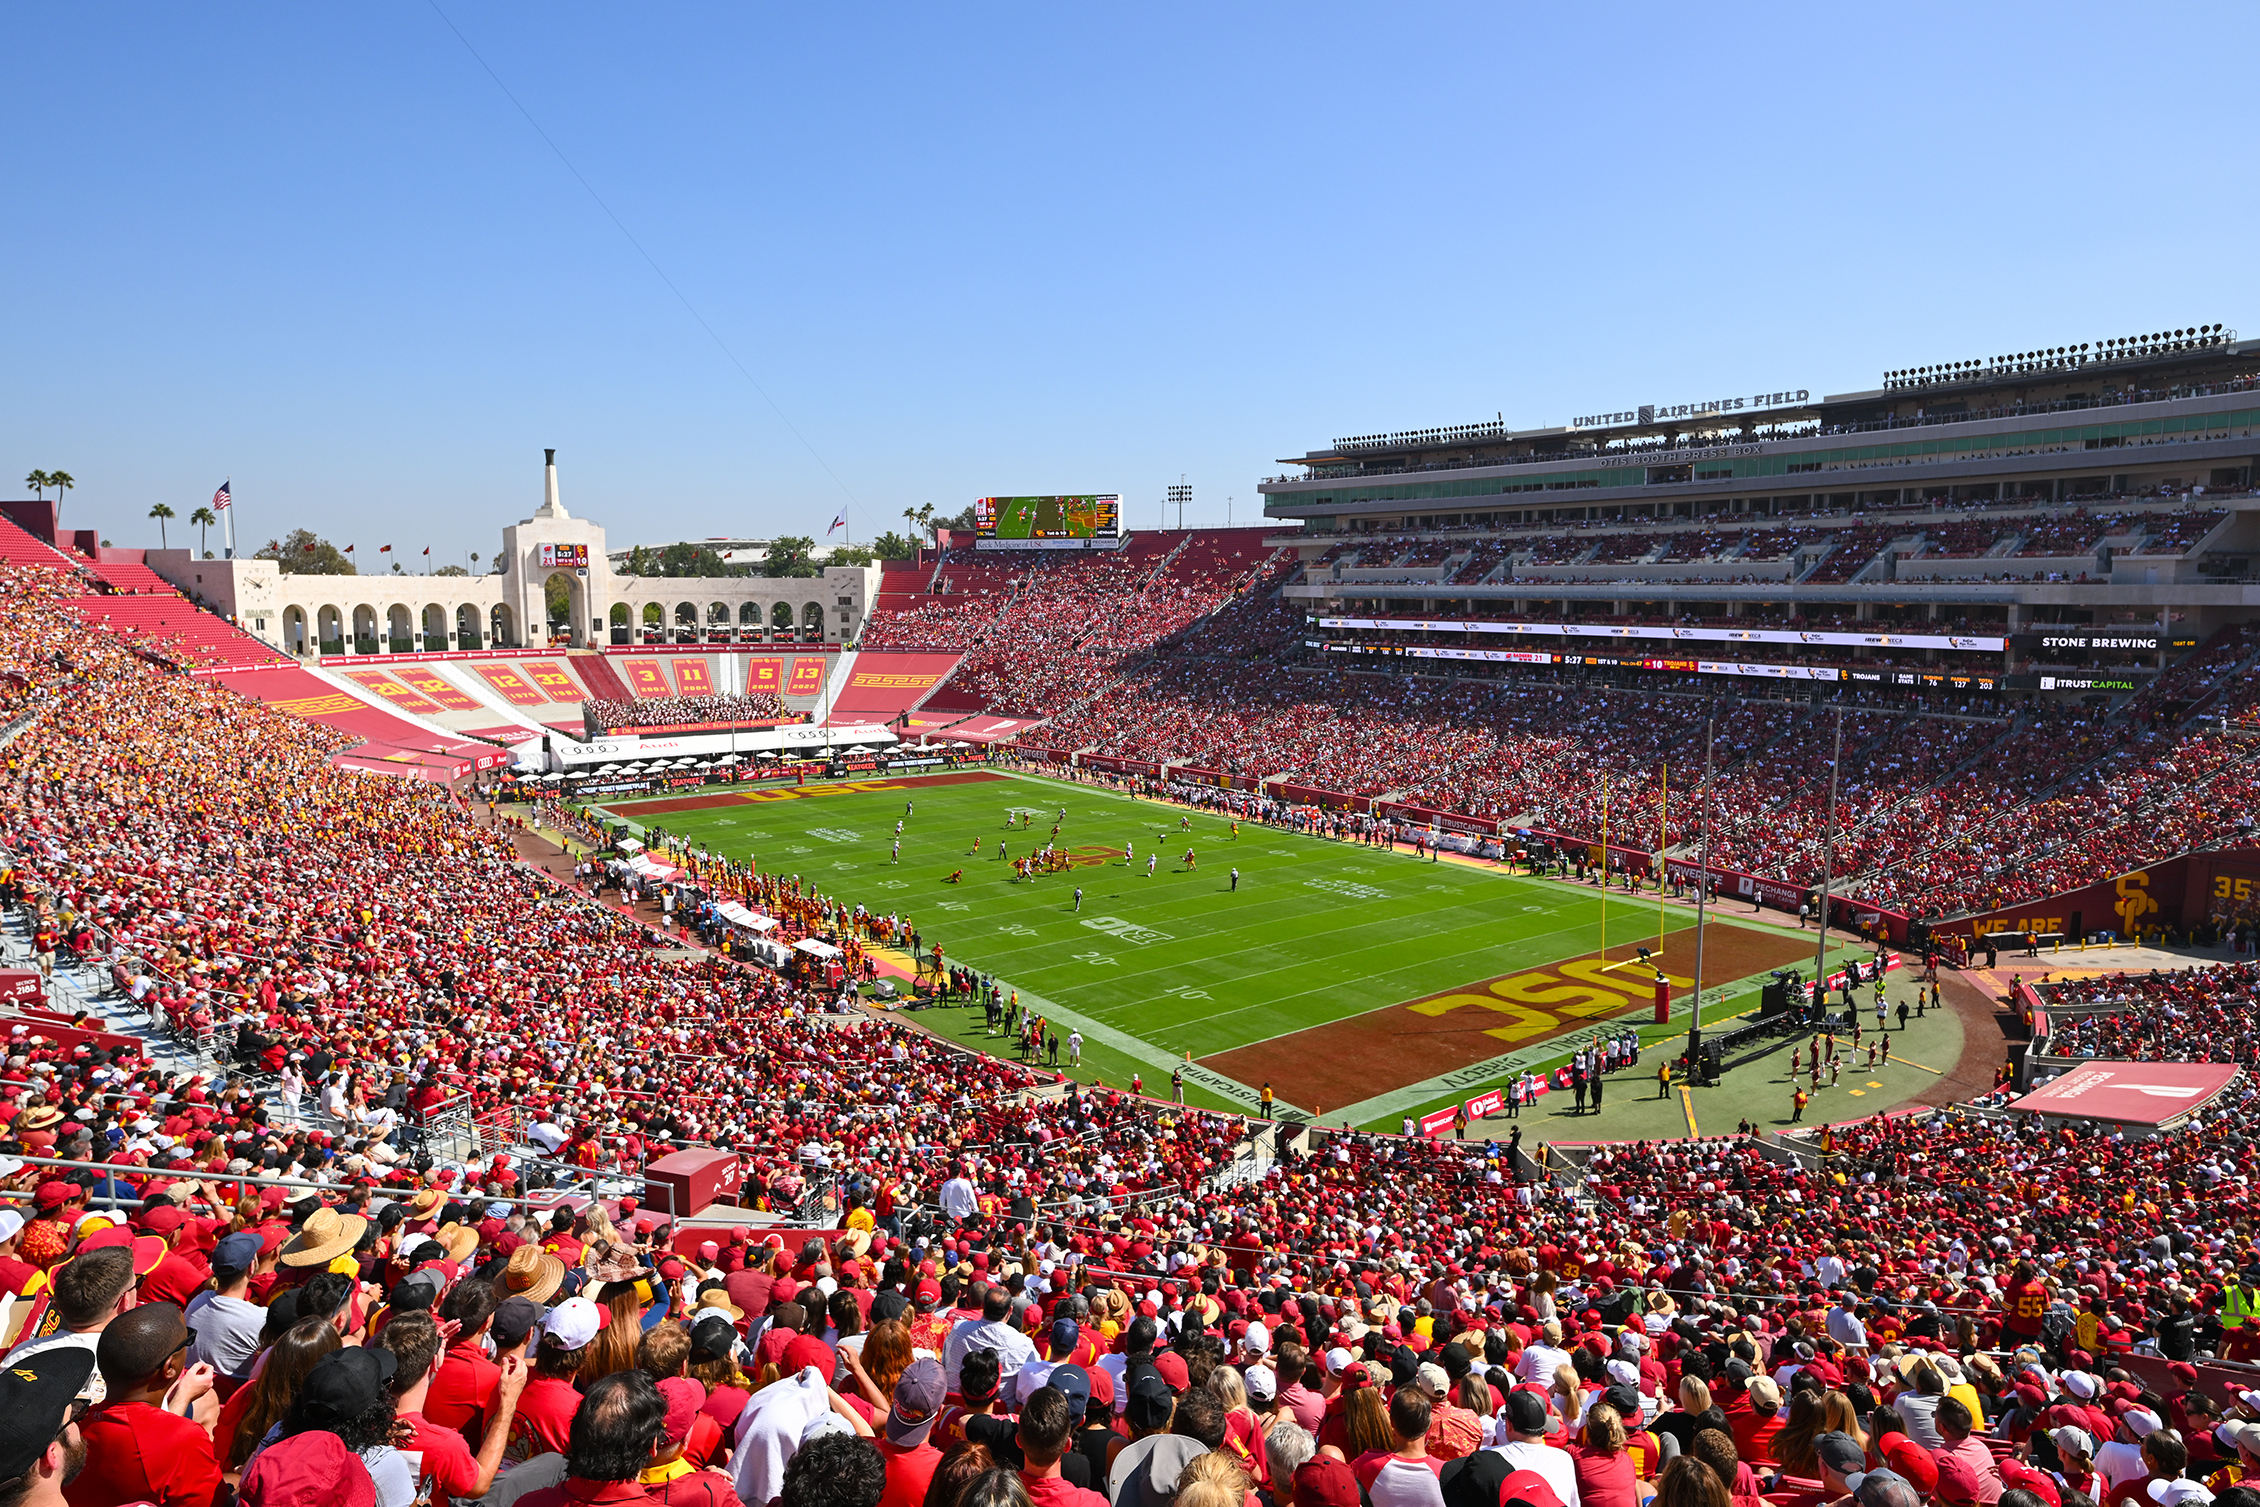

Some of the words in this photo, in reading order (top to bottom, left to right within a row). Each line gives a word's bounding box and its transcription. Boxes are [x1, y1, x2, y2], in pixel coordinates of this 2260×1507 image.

[1573, 411, 1635, 428] UNITED
[1658, 397, 1744, 418] AIRLINES
[1754, 389, 1810, 407] FIELD
[1600, 457, 1628, 467] OTIS
[1633, 453, 1678, 464] BOOTH
[1684, 449, 1727, 460] PRESS
[1733, 445, 1763, 456] BOX
[994, 540, 1021, 548] Medicine
[1022, 540, 1029, 548] of
[2042, 637, 2086, 647] STONE
[2092, 638, 2157, 649] BREWING
[1565, 656, 1582, 664] 5:27
[1652, 660, 1663, 669] 10
[535, 673, 570, 685] 33
[638, 670, 656, 682] 3
[682, 669, 702, 681] 11
[758, 668, 774, 679] 5
[796, 668, 819, 679] 13
[1852, 673, 1880, 681] TROJANS
[412, 680, 453, 692] 32
[490, 676, 523, 688] 12
[2056, 679, 2134, 689] ITRUSTCAPITAL
[369, 682, 409, 696] 20
[639, 741, 679, 750] Audi
[1016, 747, 1050, 760] SEATGEEK
[462, 763, 471, 773] Audi
[736, 780, 909, 802] USC
[1755, 882, 1797, 900] PECHANGA
[2213, 876, 2251, 900] 35
[998, 924, 1036, 936] 30
[1973, 919, 2009, 939] WE
[2016, 917, 2062, 934] ARE
[1071, 951, 1116, 966] 20
[15, 979, 36, 987] SECTION
[16, 984, 37, 995] 218B
[1164, 985, 1209, 1000] 10
[1406, 959, 1704, 1043] USC
[1441, 1056, 1527, 1089] DIRECTV
[722, 1161, 737, 1176] SECTION
[724, 1170, 735, 1186] 217
[1563, 1262, 1580, 1278] 33
[2018, 1296, 2044, 1318] 55
